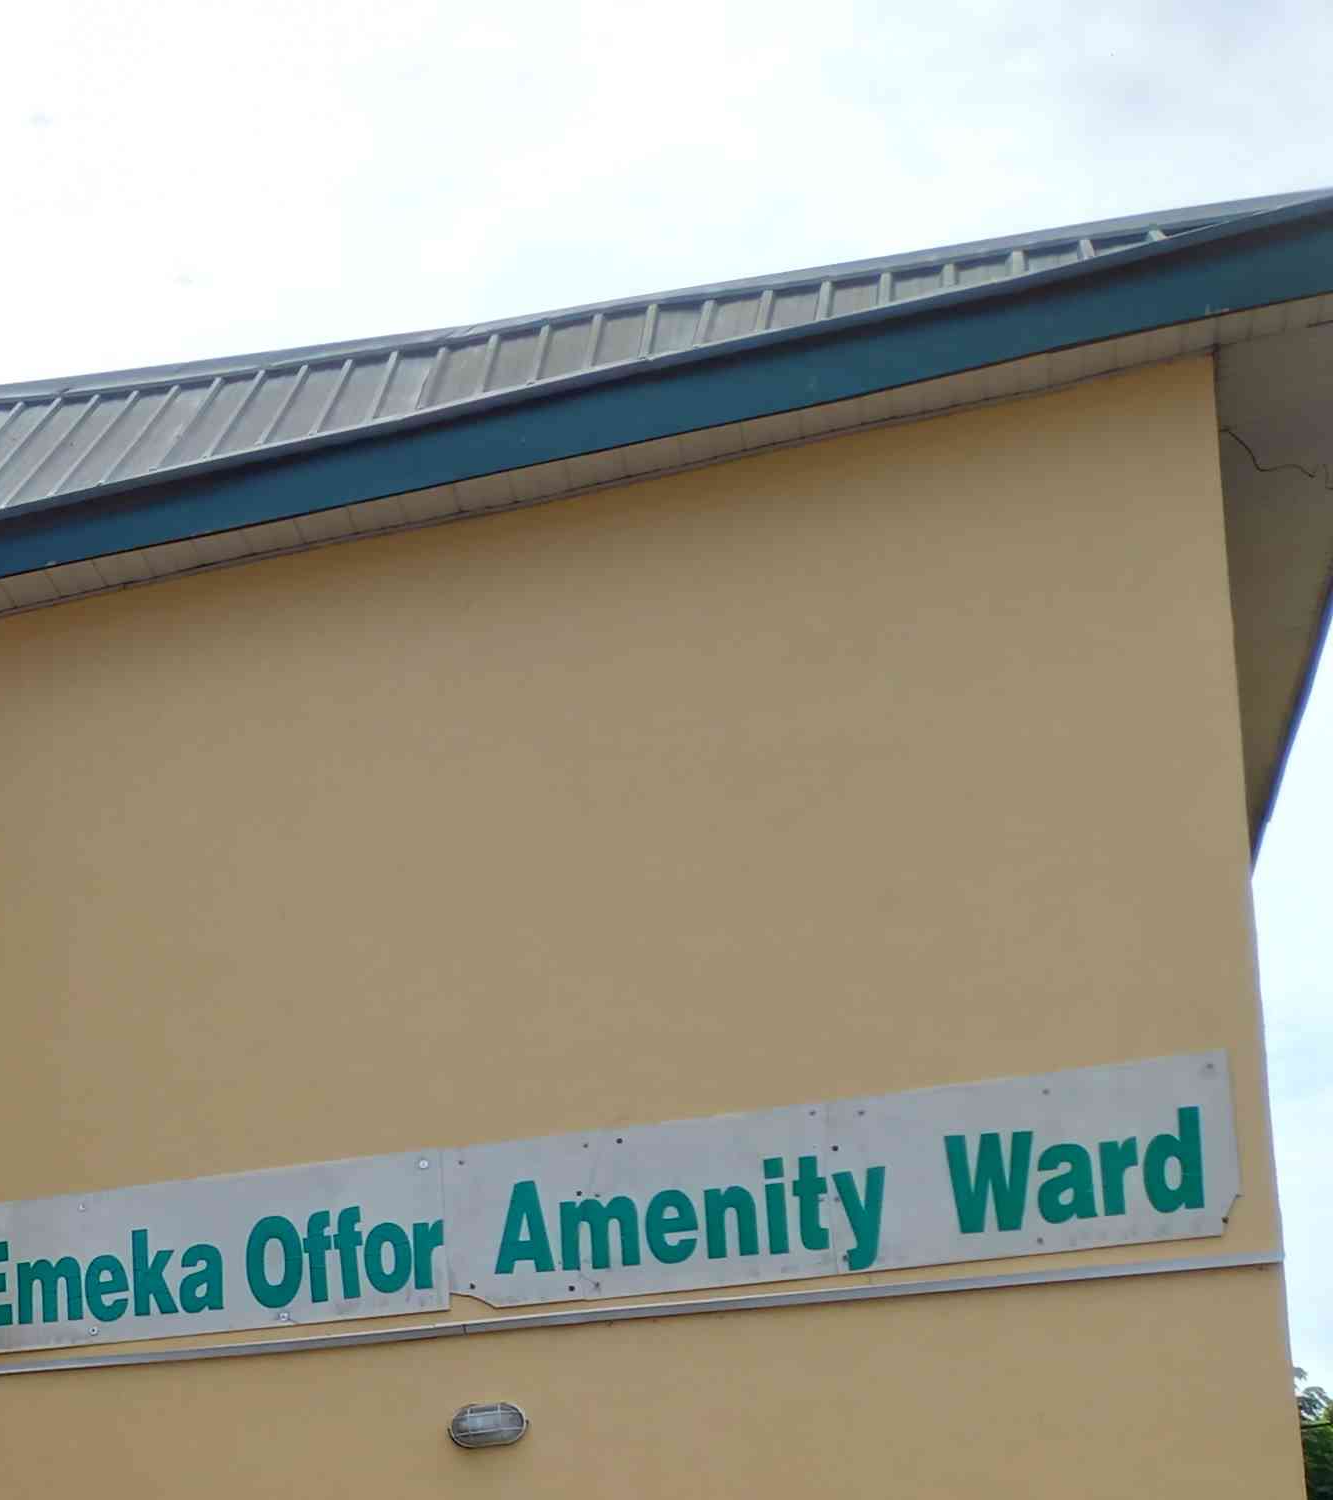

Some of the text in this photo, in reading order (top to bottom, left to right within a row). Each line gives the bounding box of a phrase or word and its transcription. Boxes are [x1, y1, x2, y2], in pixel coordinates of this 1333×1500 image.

[245, 1204, 445, 1309] Offor
[495, 1155, 885, 1275] Amenity
[945, 1105, 1205, 1232] Ward
